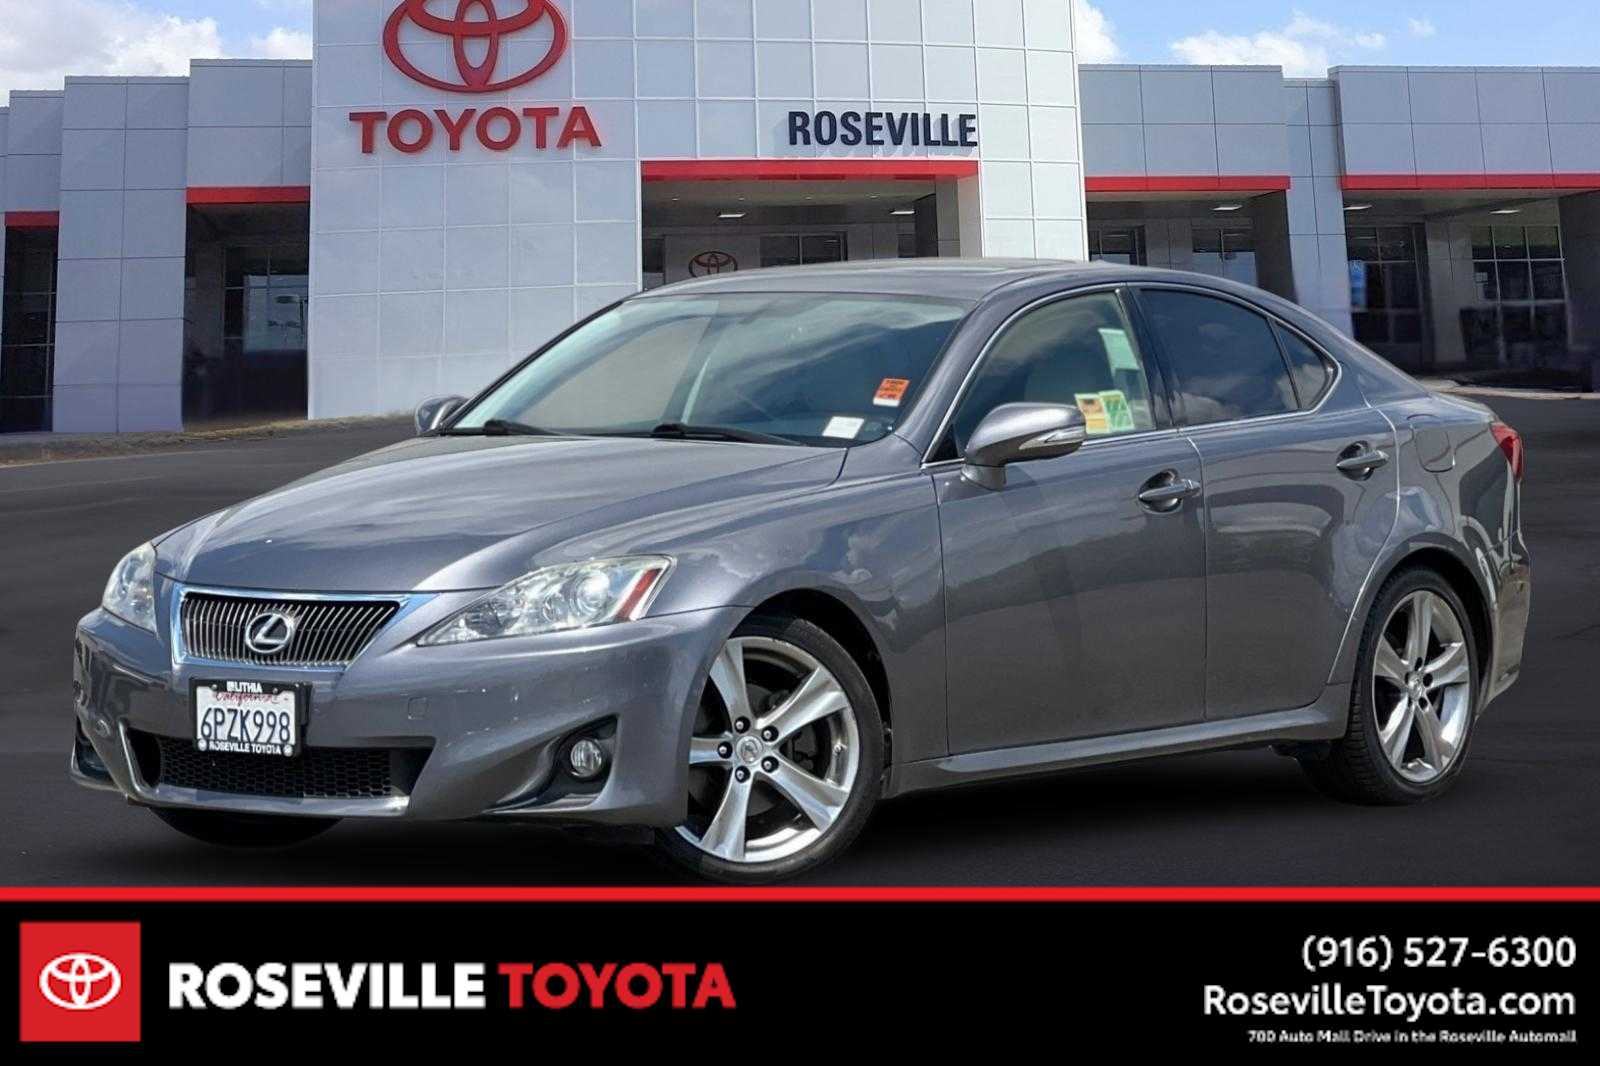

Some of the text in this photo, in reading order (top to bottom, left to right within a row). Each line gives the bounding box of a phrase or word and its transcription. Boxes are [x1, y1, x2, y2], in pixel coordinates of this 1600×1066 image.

[350, 106, 602, 154] TOYOTA
[789, 111, 979, 147] ROSEVILLE
[235, 681, 262, 693] LITHIA
[201, 708, 290, 745] 6PZK998
[209, 741, 282, 755] ROSEVILLE TOYOTA
